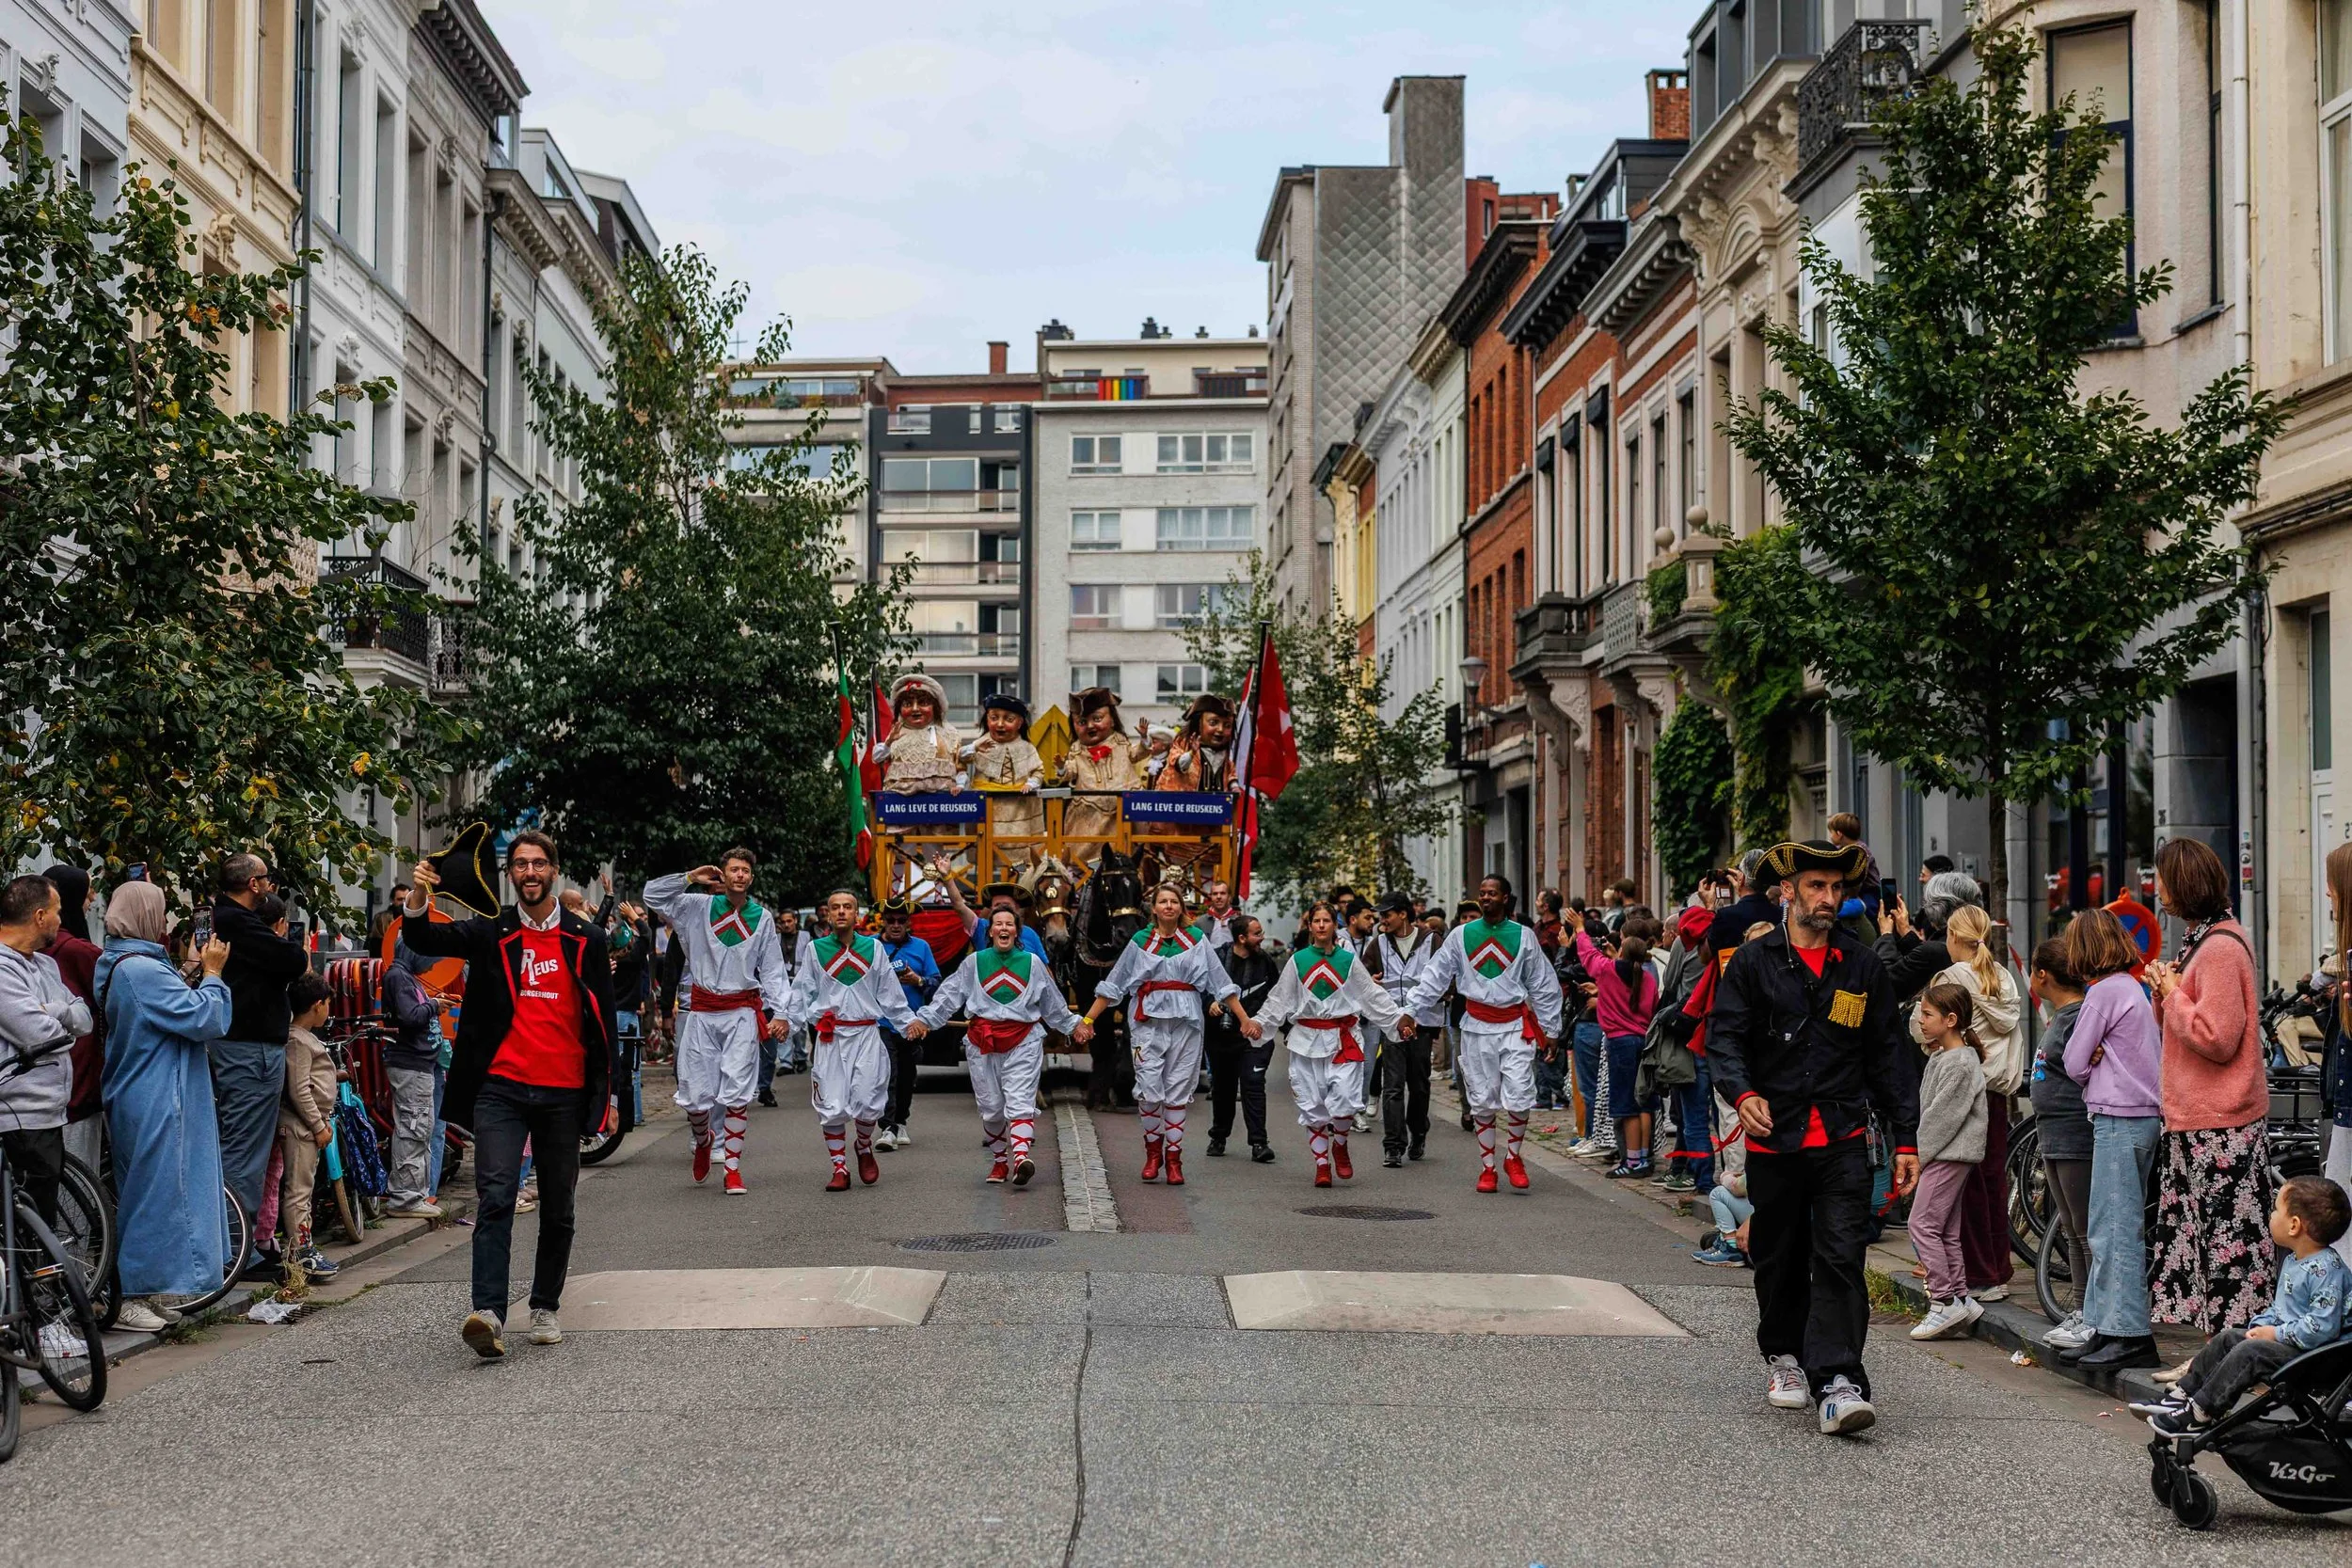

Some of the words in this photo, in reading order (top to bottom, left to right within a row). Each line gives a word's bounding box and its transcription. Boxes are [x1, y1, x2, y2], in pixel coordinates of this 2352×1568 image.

[885, 803, 906, 814] LANG
[908, 803, 927, 813] LEVE
[929, 803, 939, 813] DE
[940, 803, 977, 813] REUSKENS
[1131, 801, 1152, 812] LANG
[1154, 802, 1173, 813] LEVE
[1174, 803, 1184, 813] DE
[1185, 803, 1223, 814] REUSKENS
[520, 990, 559, 1000] BORGERHOUT
[2268, 1461, 2336, 1483] K2Go
